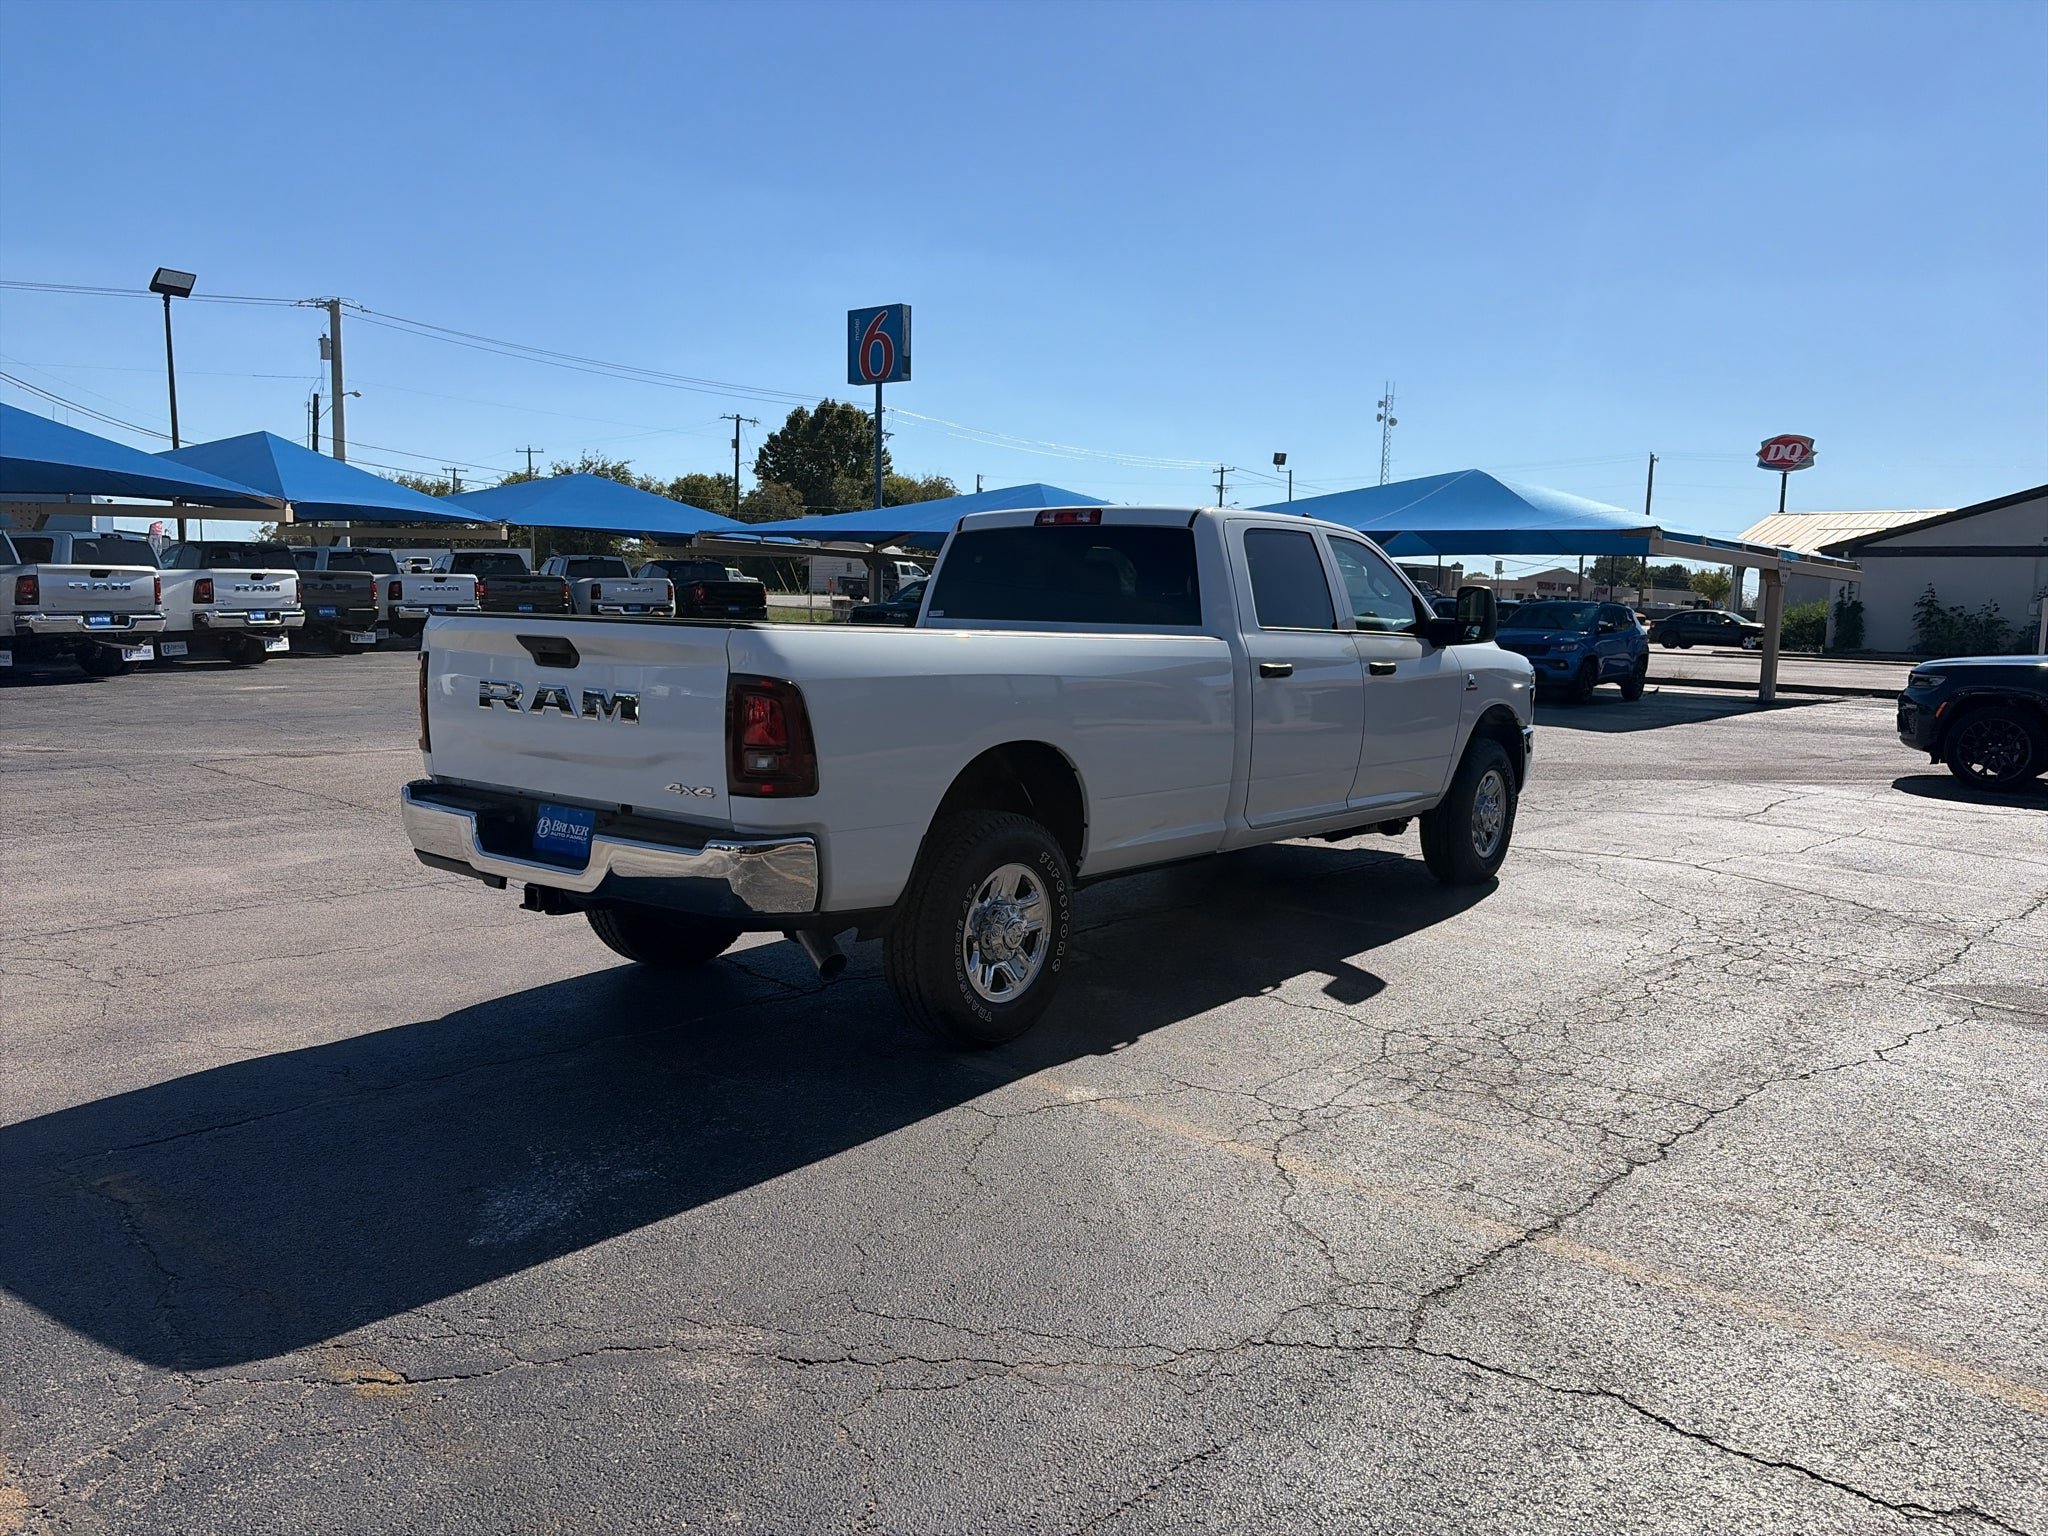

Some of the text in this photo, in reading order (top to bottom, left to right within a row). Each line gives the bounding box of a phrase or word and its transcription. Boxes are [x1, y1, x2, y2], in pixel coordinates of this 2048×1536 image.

[859, 310, 894, 381] 6
[1766, 443, 1803, 462] DQ
[68, 581, 131, 591] RAM
[235, 583, 280, 592] RAM
[478, 678, 641, 726] RAM
[550, 830, 566, 839] AUTO
[565, 833, 589, 842] FAMILY
[551, 819, 589, 837] BRUNER
